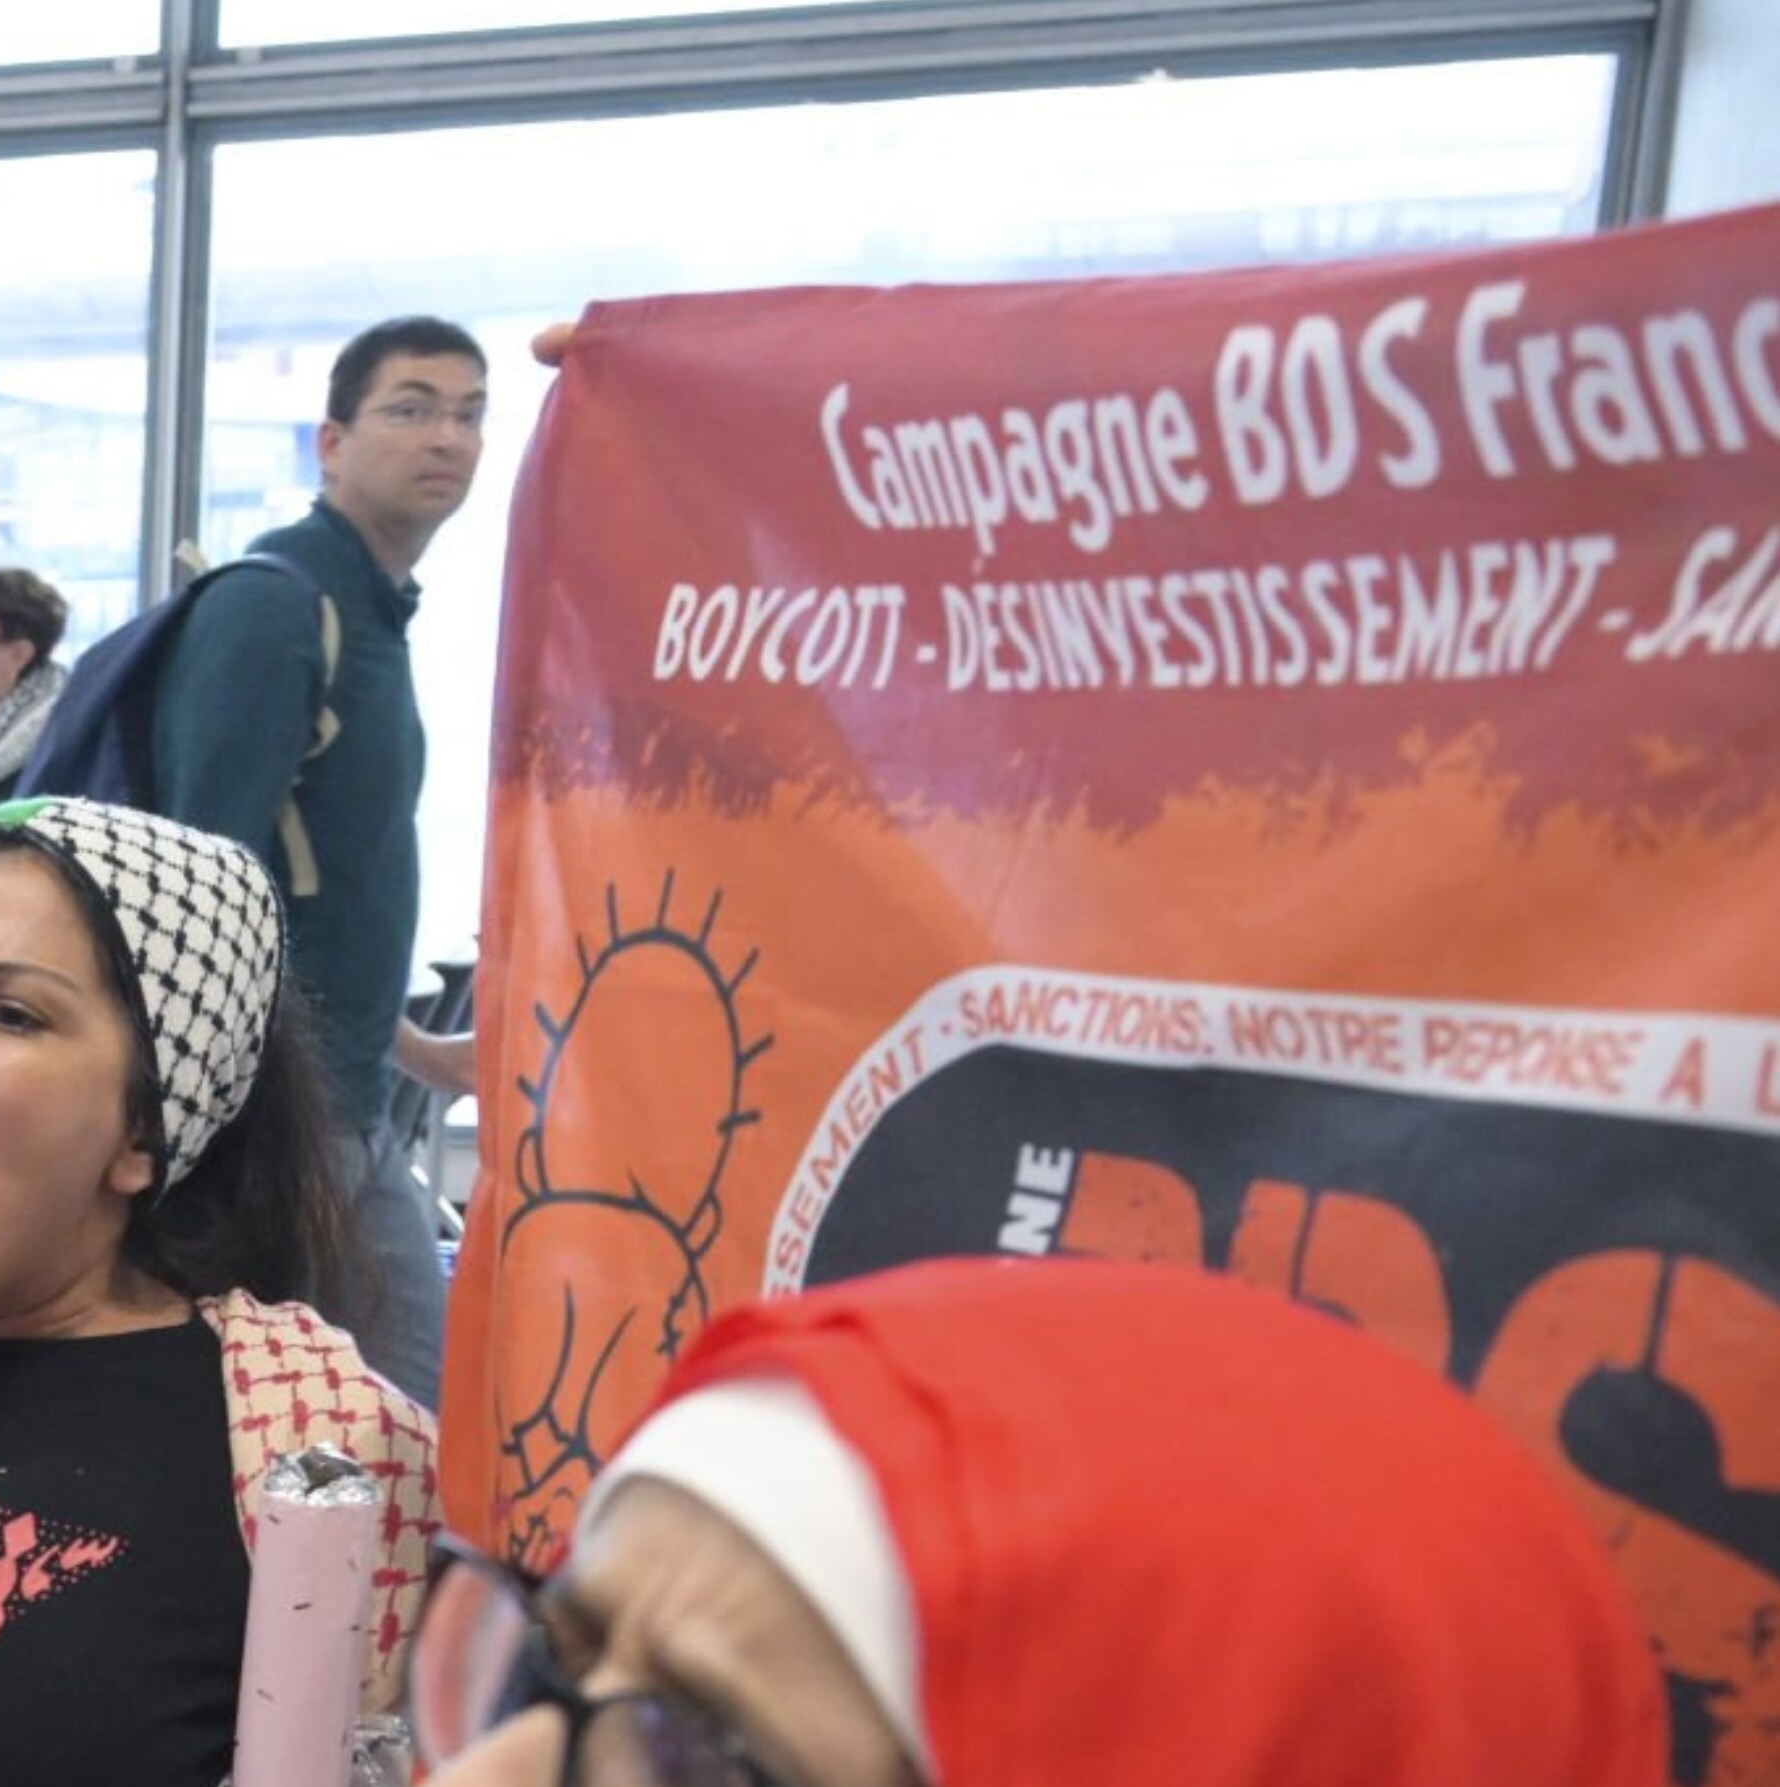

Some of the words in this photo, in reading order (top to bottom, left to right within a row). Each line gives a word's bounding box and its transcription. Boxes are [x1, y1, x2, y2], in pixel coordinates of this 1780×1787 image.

[819, 384, 1207, 553] Campagne
[1213, 298, 1442, 508] BDS
[652, 584, 906, 692] BOYCOTT
[772, 1025, 925, 1296] SEMENT
[1226, 1001, 1406, 1074] NOTRE
